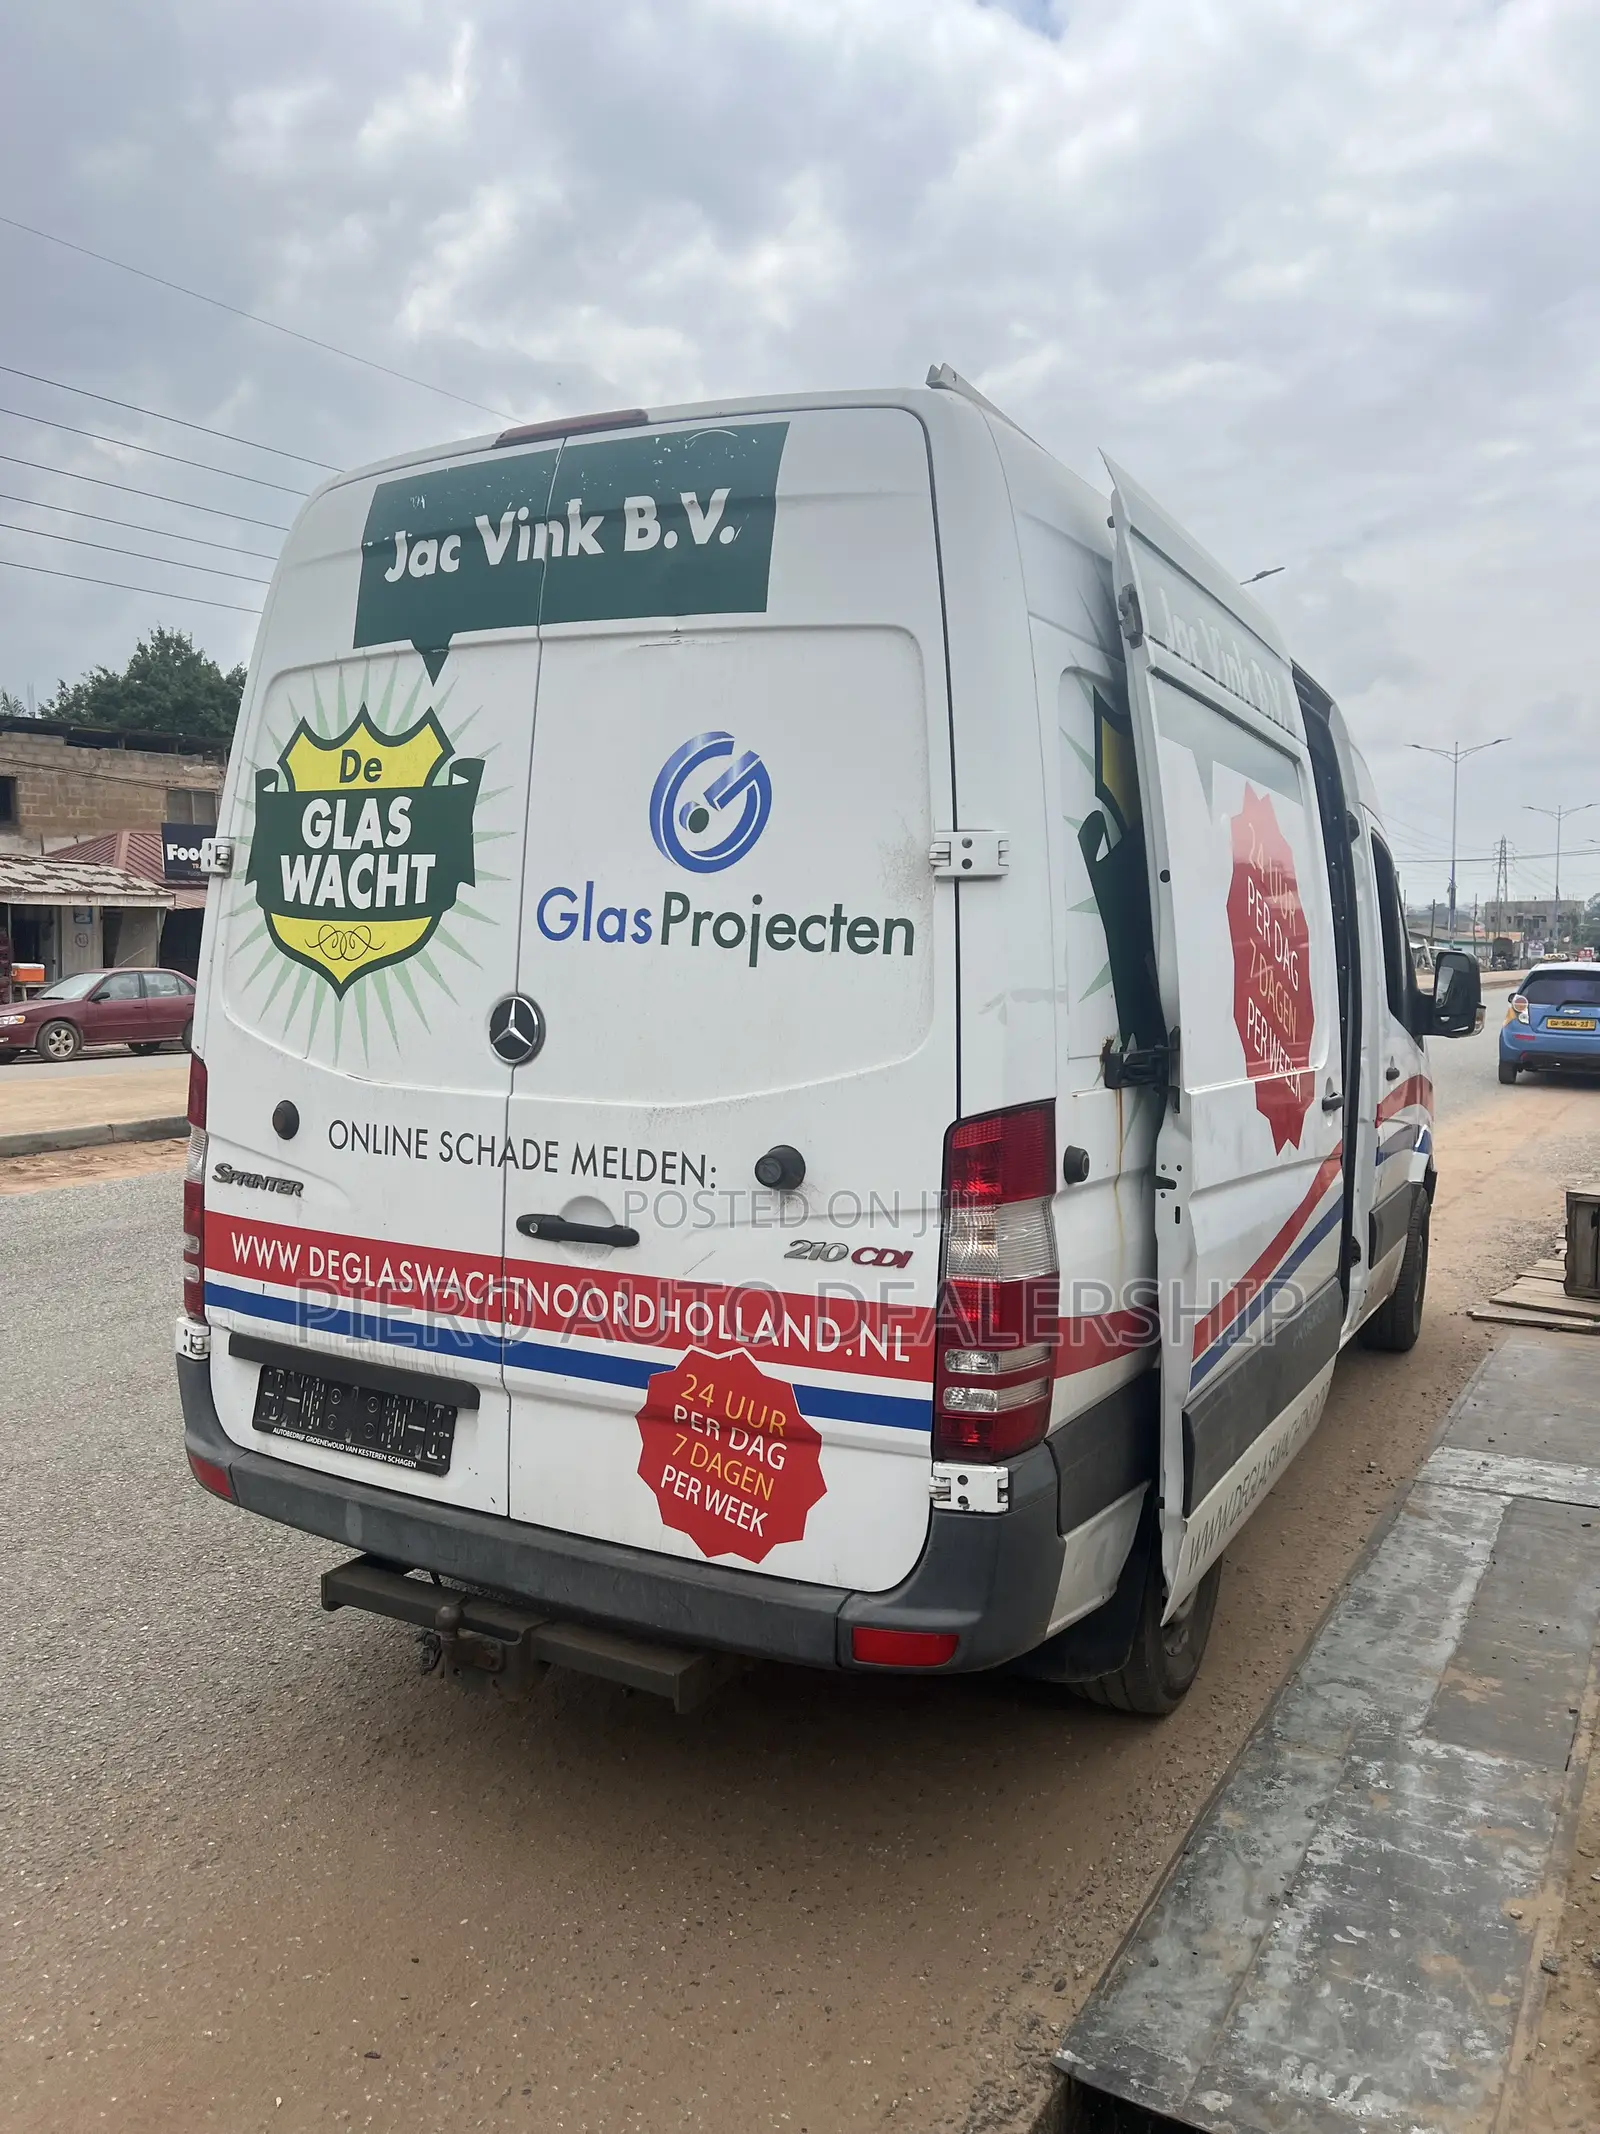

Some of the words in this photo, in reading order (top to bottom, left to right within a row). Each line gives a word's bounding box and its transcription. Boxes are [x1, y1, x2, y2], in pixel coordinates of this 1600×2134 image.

[384, 530, 461, 583] Jac
[474, 498, 605, 566] Vink
[624, 487, 737, 552] B.V.
[339, 749, 383, 783] De
[166, 843, 203, 861] Foo
[301, 796, 413, 850] GLAS
[280, 853, 436, 910] WACHT
[1248, 822, 1265, 883] 24
[1269, 857, 1297, 937] UUR
[536, 880, 915, 968] GlasProjecten
[1247, 875, 1271, 948] PER
[1274, 919, 1299, 992] DAG
[1259, 952, 1297, 1044] DAGEN
[1247, 996, 1268, 1063] PER
[1268, 1027, 1302, 1103] WEEK
[211, 1163, 304, 1198] SPRINTER
[328, 1119, 428, 1160] ONLINE
[438, 1130, 559, 1173] SCHADE
[571, 1142, 717, 1190] MELDEN:
[783, 1239, 849, 1262] 210
[851, 1246, 914, 1269] CDI
[308, 1245, 910, 1363] DEGLASWACHTNOORDHOLLAND.NL
[673, 1404, 720, 1441] PER
[728, 1427, 788, 1470] DAG
[680, 1373, 715, 1408] 24
[725, 1390, 787, 1437] UUR
[272, 1427, 306, 1441] AUTOBEDRIJF
[305, 1435, 345, 1450] GROENEWOUD
[345, 1444, 358, 1454] VAN
[358, 1448, 388, 1461] KESTEREN
[387, 1455, 417, 1468] SCHAGEN
[672, 1432, 688, 1456] 7
[690, 1442, 775, 1501] DAGEN
[660, 1464, 702, 1505] PER
[705, 1484, 769, 1538] WEEK
